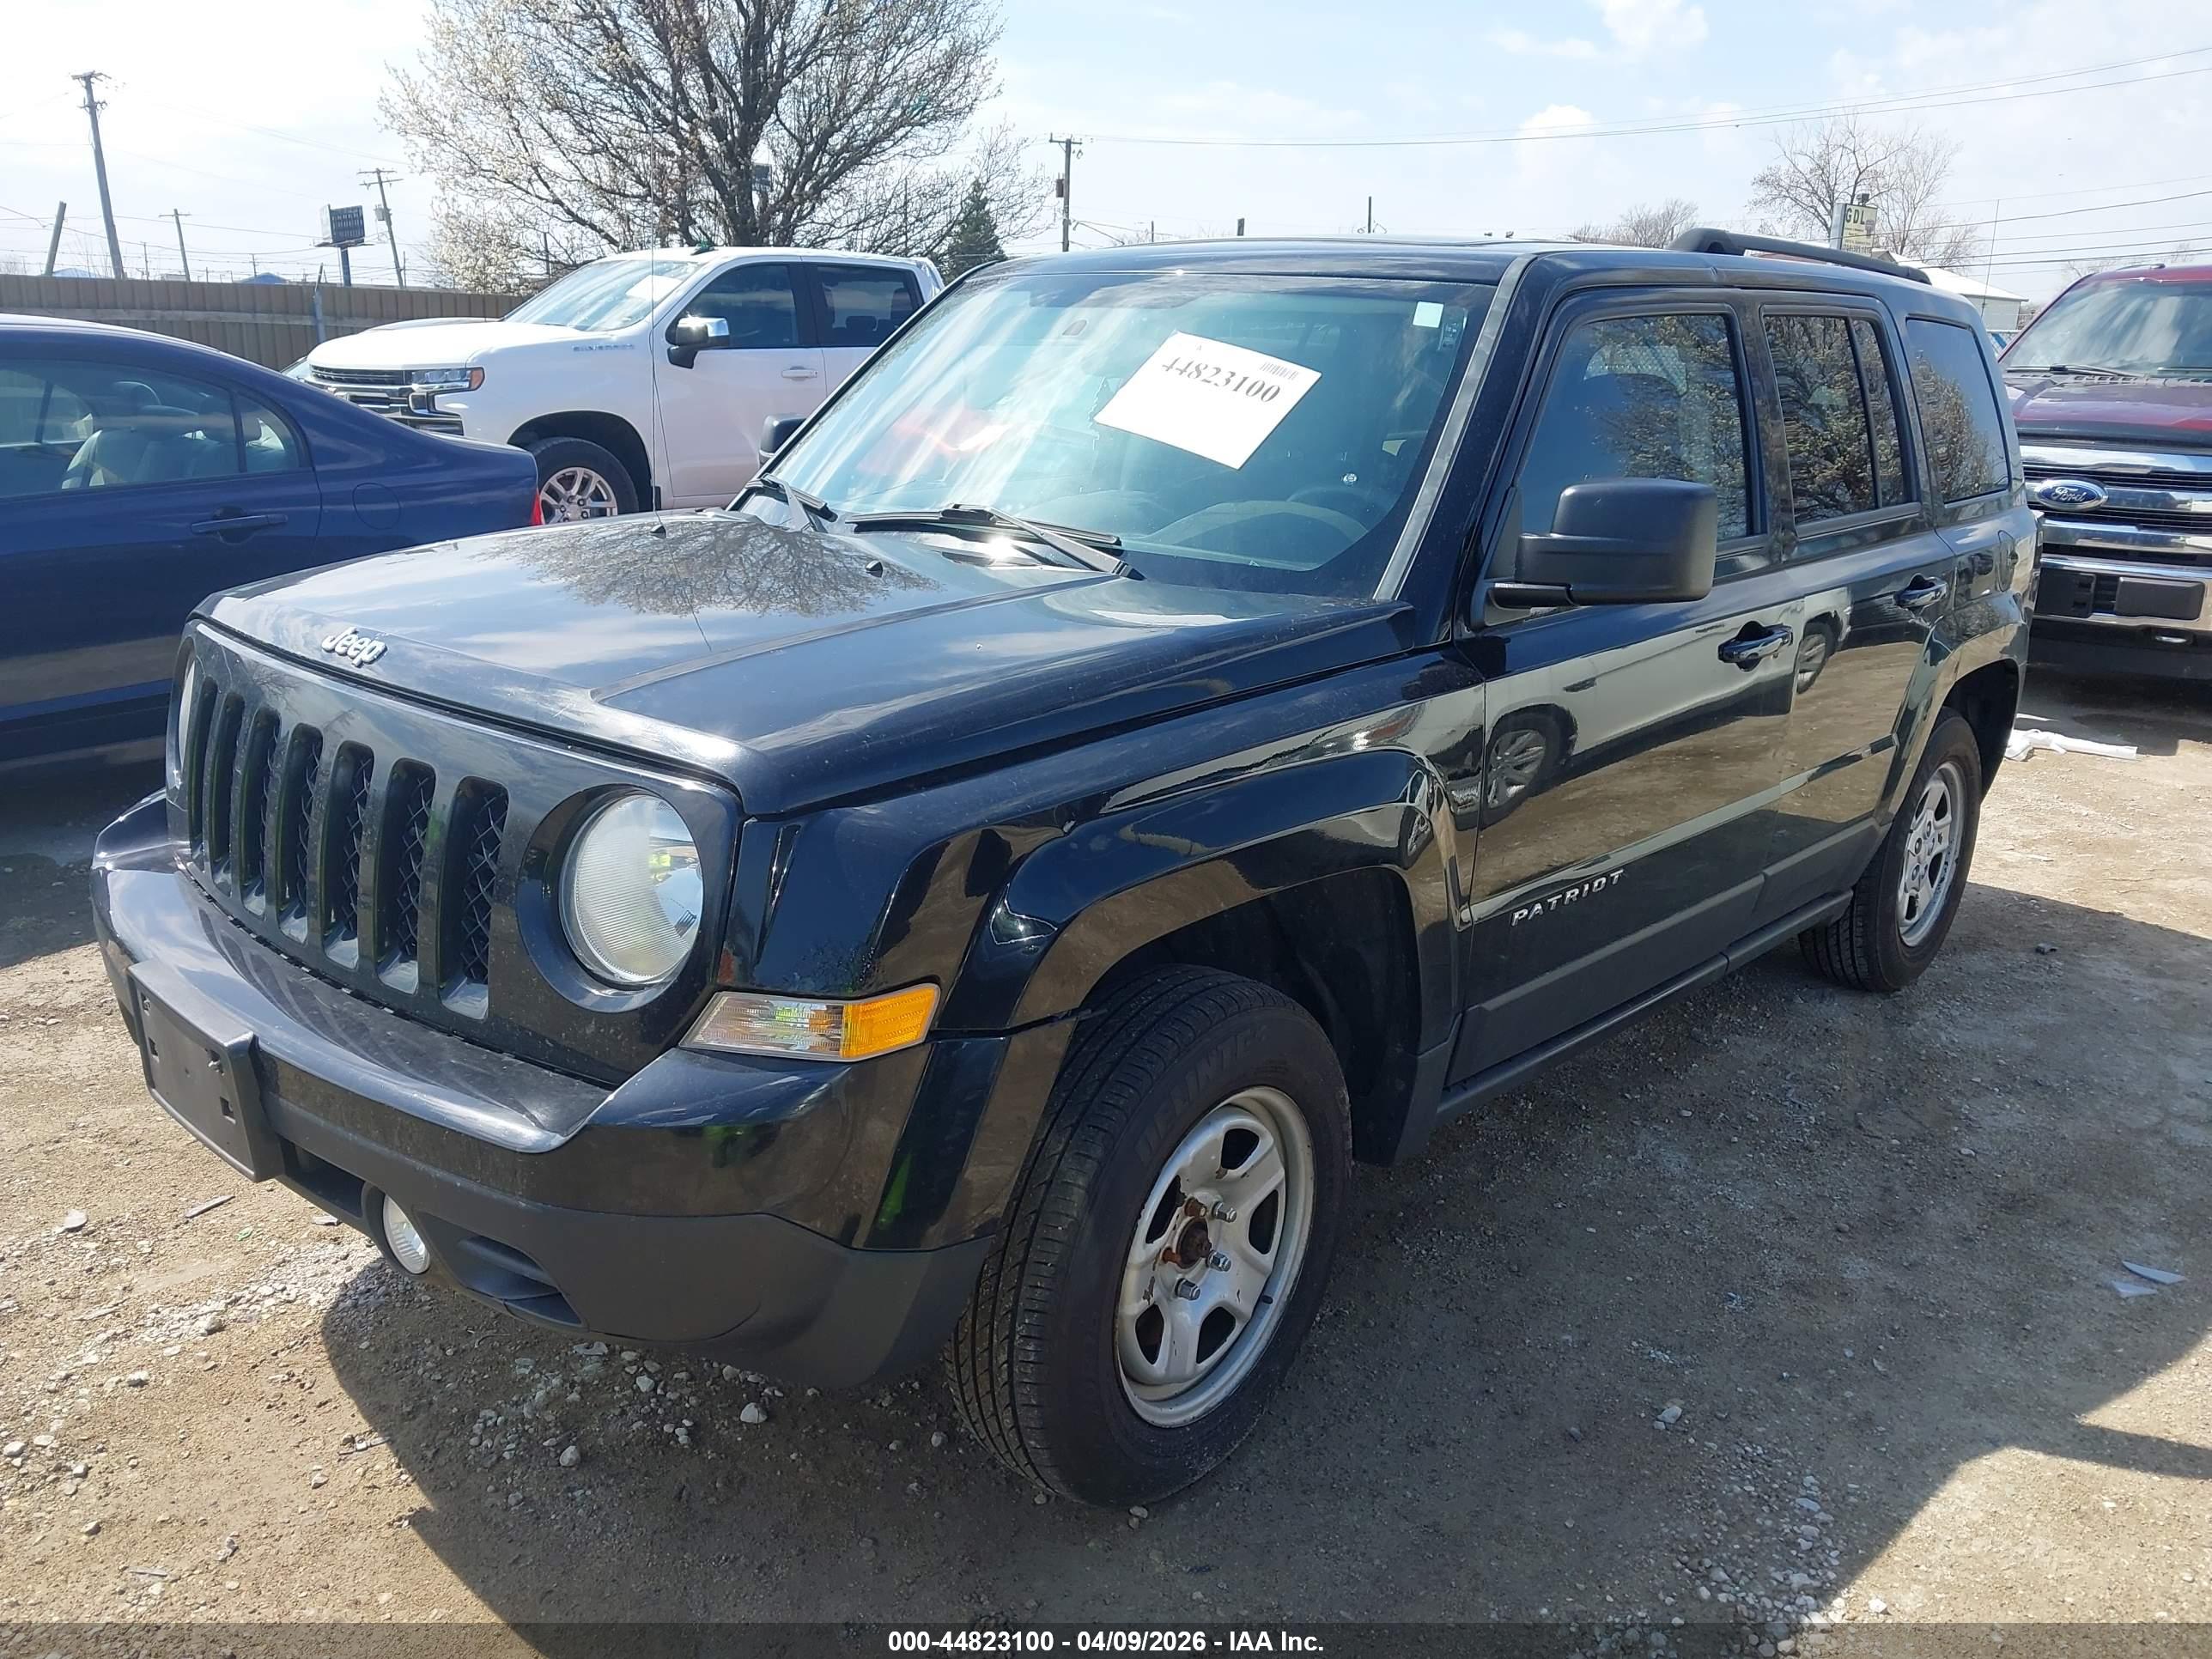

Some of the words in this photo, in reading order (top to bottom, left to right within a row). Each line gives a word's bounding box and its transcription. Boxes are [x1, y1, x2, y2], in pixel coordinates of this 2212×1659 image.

[1845, 207, 1865, 225] GDL
[1162, 356, 1281, 403] 44823100
[2051, 486, 2087, 502] Ford
[321, 626, 388, 668] Jeep
[1510, 868, 1625, 927] PATRIOT
